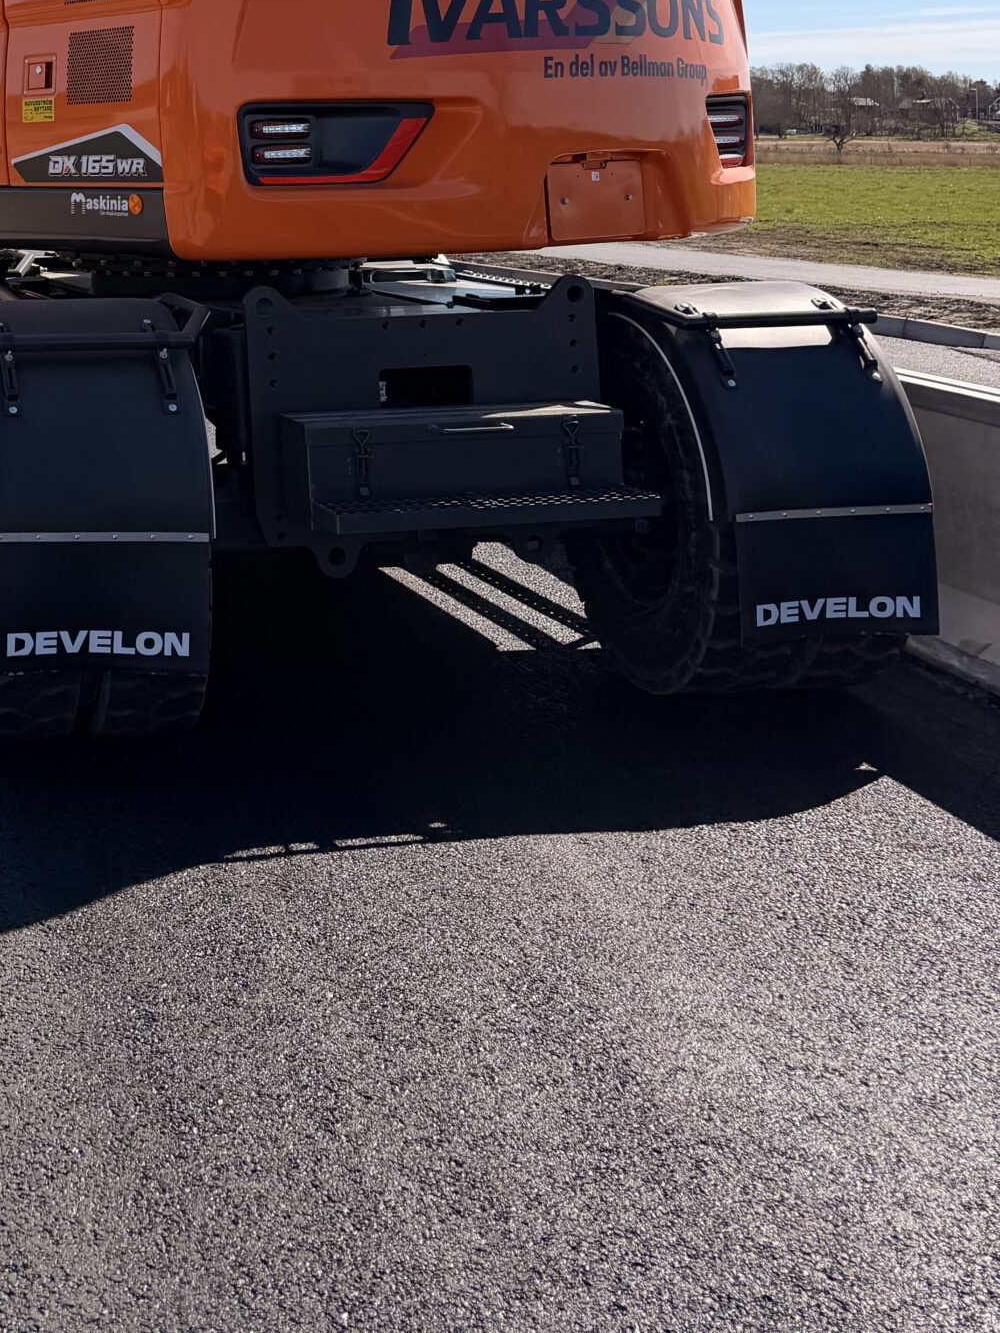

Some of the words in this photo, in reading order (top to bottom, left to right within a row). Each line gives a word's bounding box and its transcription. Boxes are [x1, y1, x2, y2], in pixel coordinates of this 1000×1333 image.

[543, 56, 564, 78] En
[568, 54, 594, 78] del
[599, 59, 617, 77] av
[620, 54, 674, 77] Bellman
[676, 57, 707, 85] Group
[70, 192, 129, 215] Maskinia
[756, 596, 921, 628] DEVELON
[6, 630, 191, 658] DEVELON
